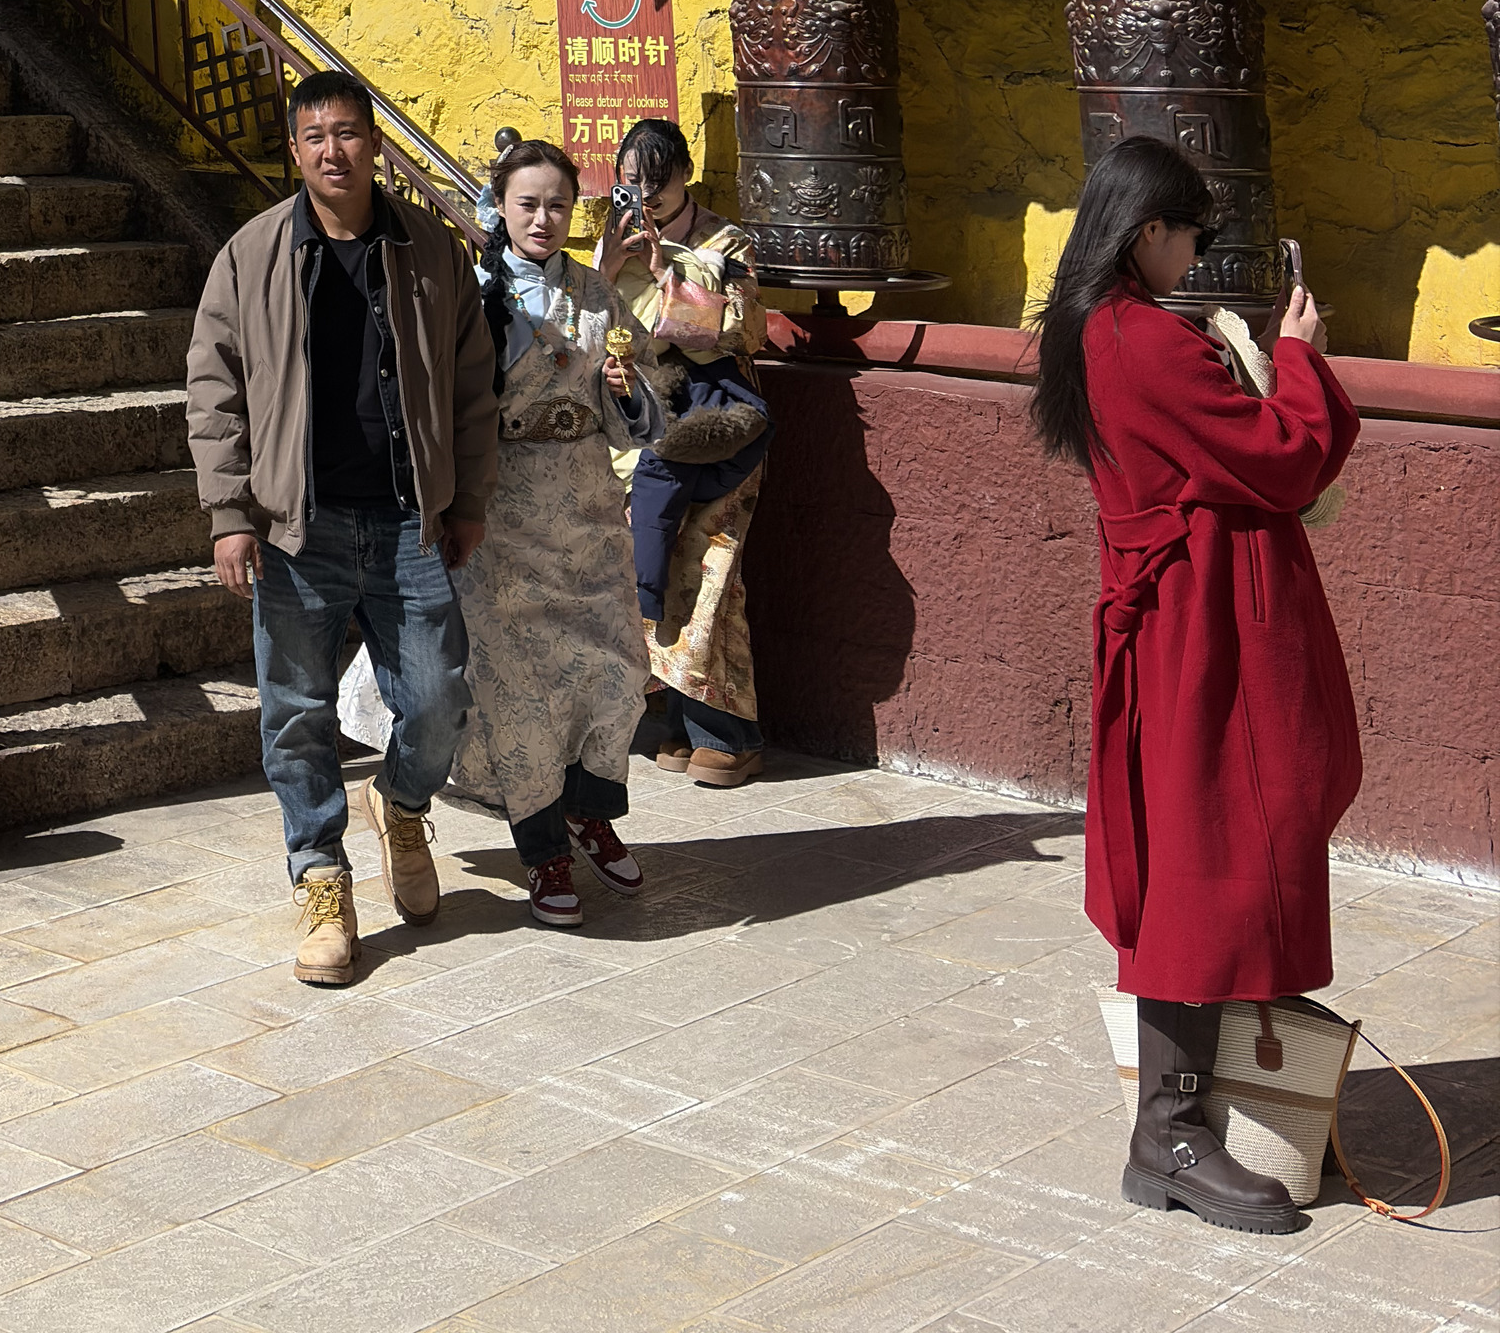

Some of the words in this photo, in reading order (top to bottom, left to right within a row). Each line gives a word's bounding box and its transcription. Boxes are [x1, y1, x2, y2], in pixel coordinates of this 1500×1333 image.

[565, 36, 669, 66] 请顺时针
[566, 93, 594, 108] Please
[596, 93, 624, 108] detour
[627, 94, 669, 109] clockwise
[569, 114, 668, 145] 方向
